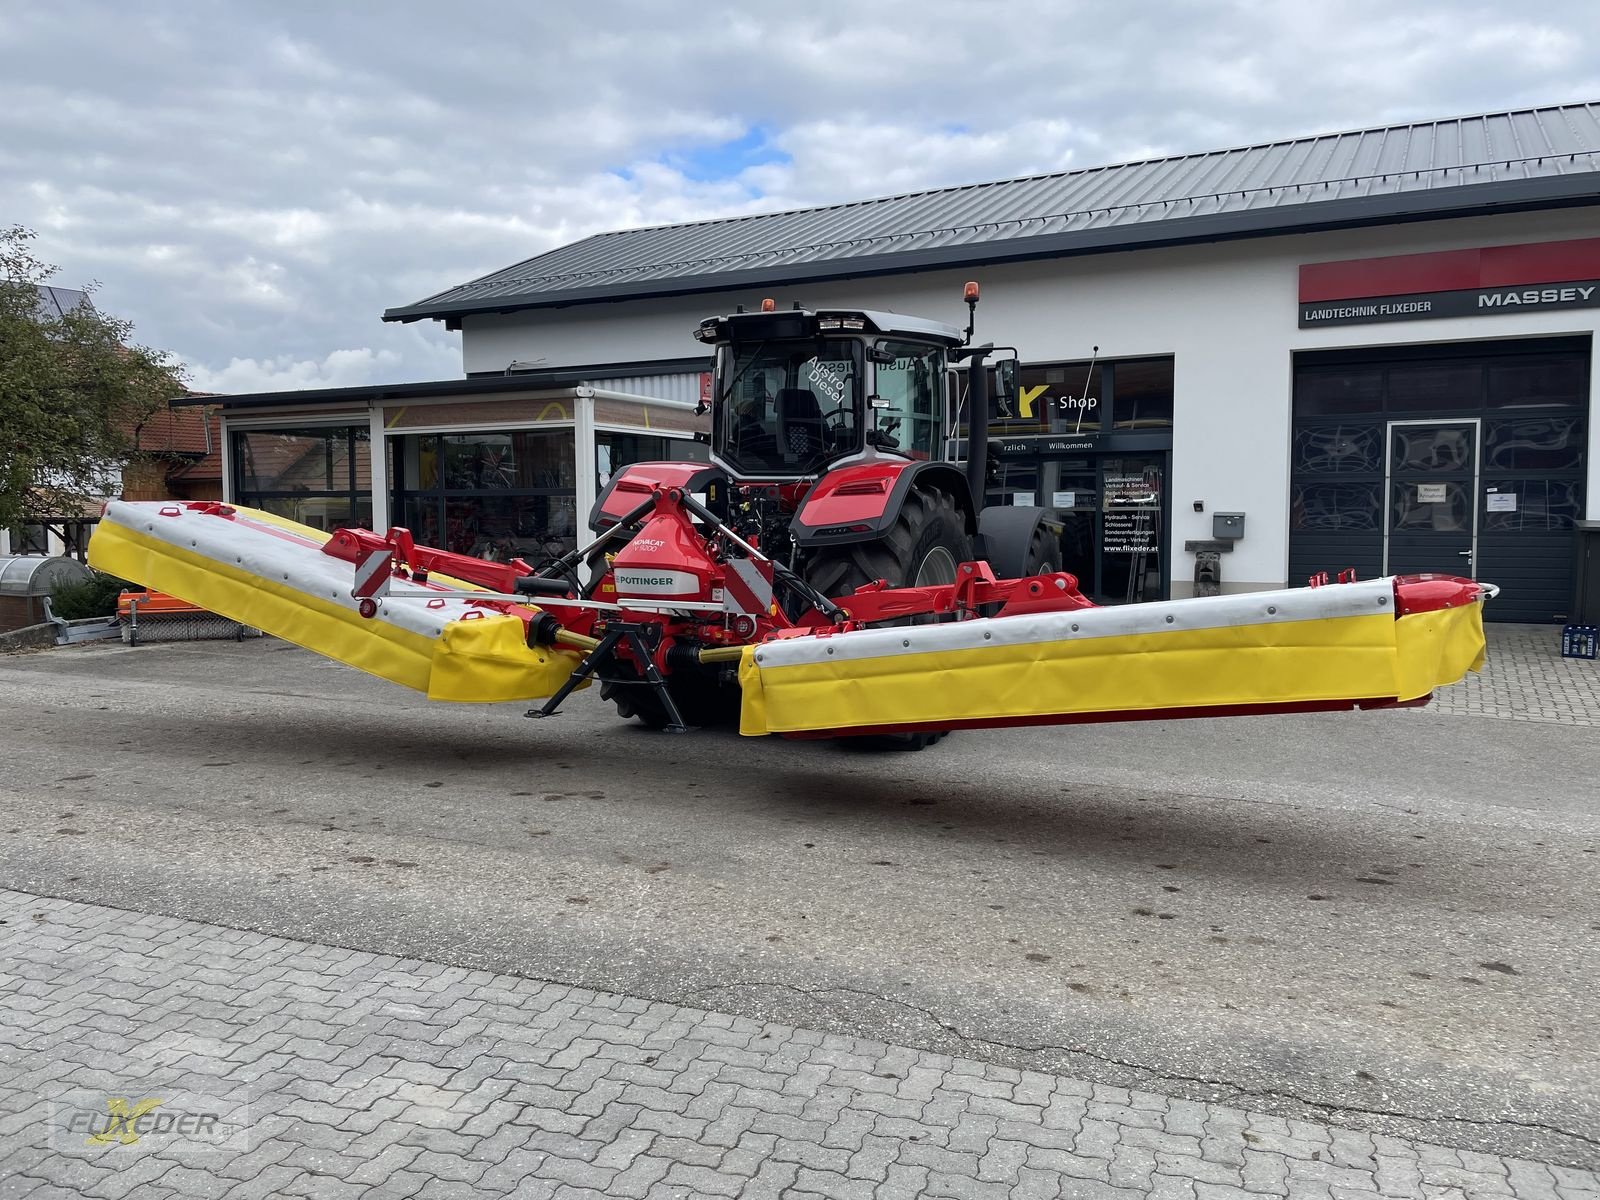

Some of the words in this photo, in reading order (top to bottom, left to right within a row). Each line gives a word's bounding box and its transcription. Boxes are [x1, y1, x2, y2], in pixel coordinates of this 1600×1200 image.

[1478, 286, 1596, 307] MASSEY
[1305, 305, 1378, 320] LANDTECHNIK
[1380, 301, 1432, 315] FLIXEDER
[807, 355, 845, 390] Austro
[808, 370, 845, 404] Diesel
[1060, 396, 1097, 410] Shop
[1003, 443, 1027, 451] rzlich
[1048, 442, 1093, 450] Willkommen
[632, 538, 665, 547] NOVACAT
